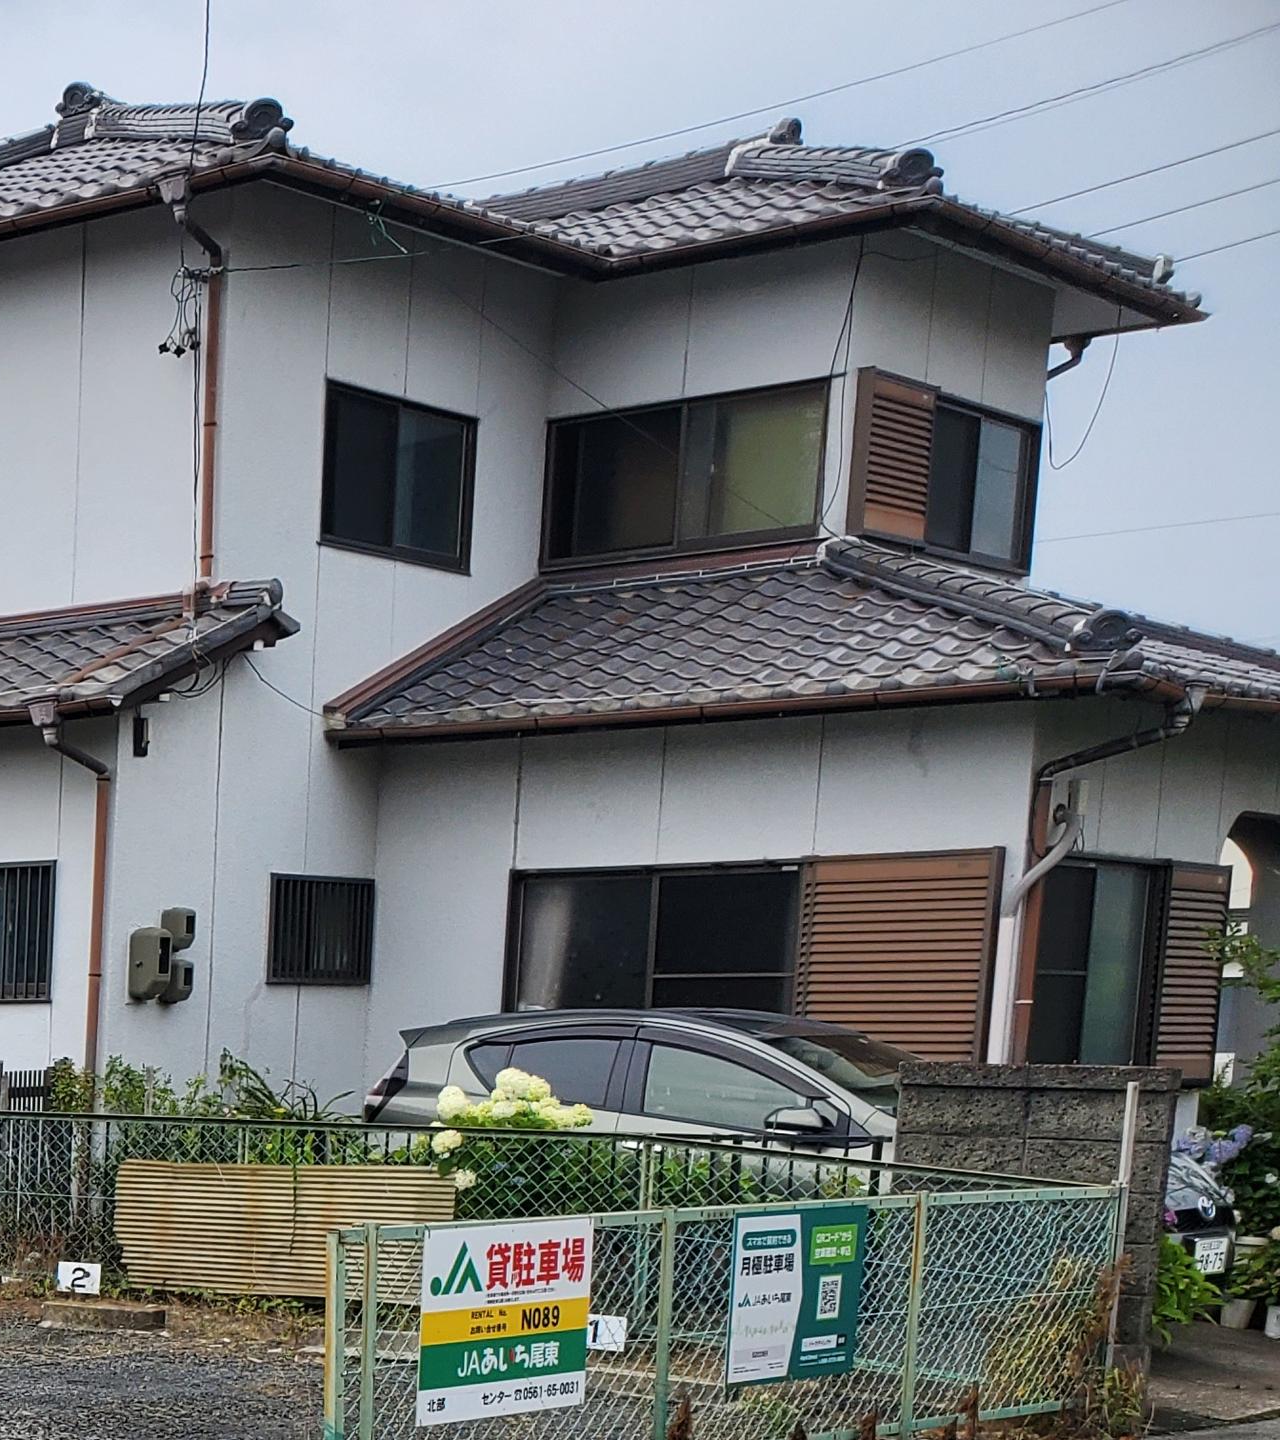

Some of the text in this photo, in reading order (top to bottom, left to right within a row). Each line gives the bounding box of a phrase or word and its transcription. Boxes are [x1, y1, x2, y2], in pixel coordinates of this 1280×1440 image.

[71, 1267, 87, 1289] 2
[485, 1238, 585, 1290] 貸駐車場
[471, 1309, 494, 1320] RENTAL
[589, 1319, 599, 1344] 1
[457, 1341, 560, 1378] JAあいち尾東
[427, 1381, 580, 1413] 北部 センター 0561-65-0031
